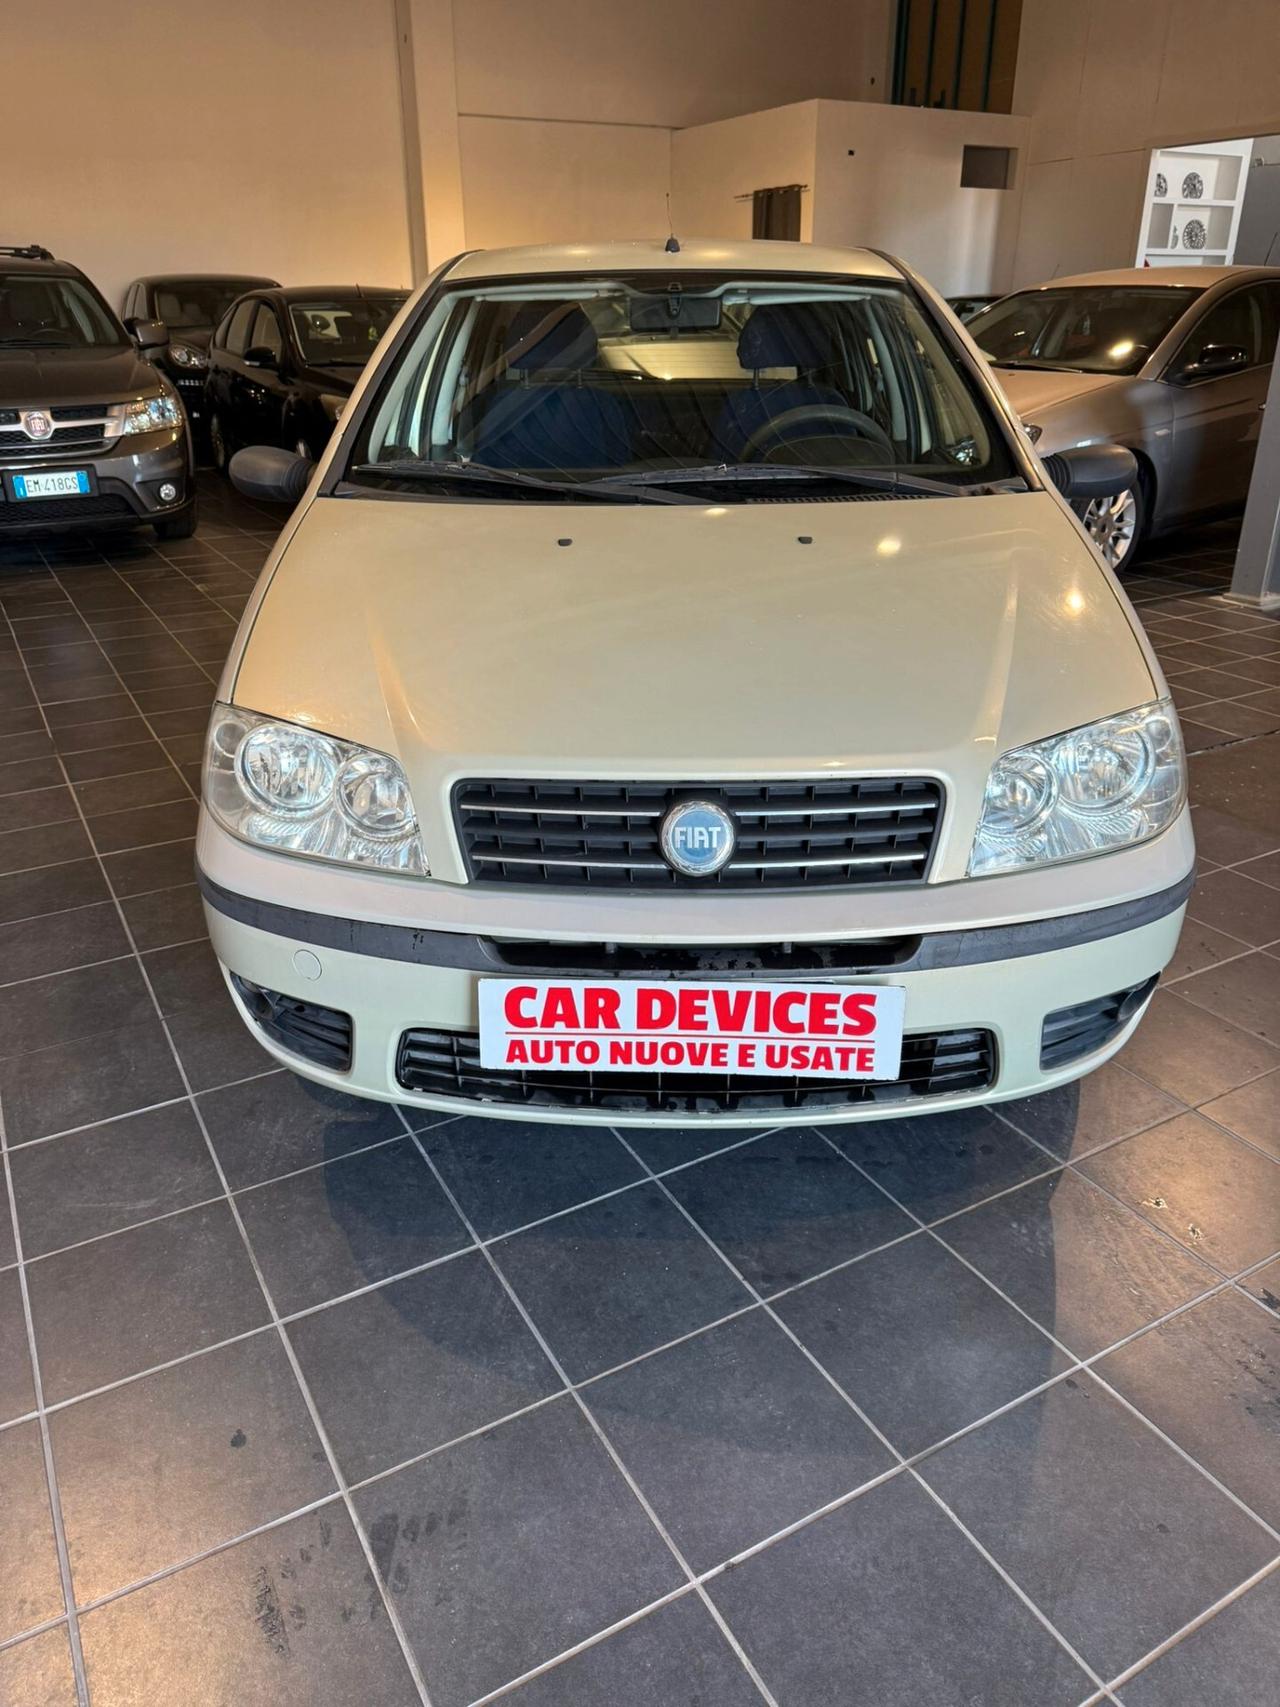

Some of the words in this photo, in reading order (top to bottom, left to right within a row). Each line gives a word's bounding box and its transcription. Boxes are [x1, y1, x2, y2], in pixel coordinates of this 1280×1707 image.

[674, 826, 721, 849] FIAT
[503, 985, 621, 1030] CAR
[635, 988, 877, 1036] DEVICES
[506, 1039, 600, 1066] AUTO
[609, 1041, 729, 1068] NUOVE
[737, 1043, 756, 1068] E
[764, 1044, 875, 1072] USATE
